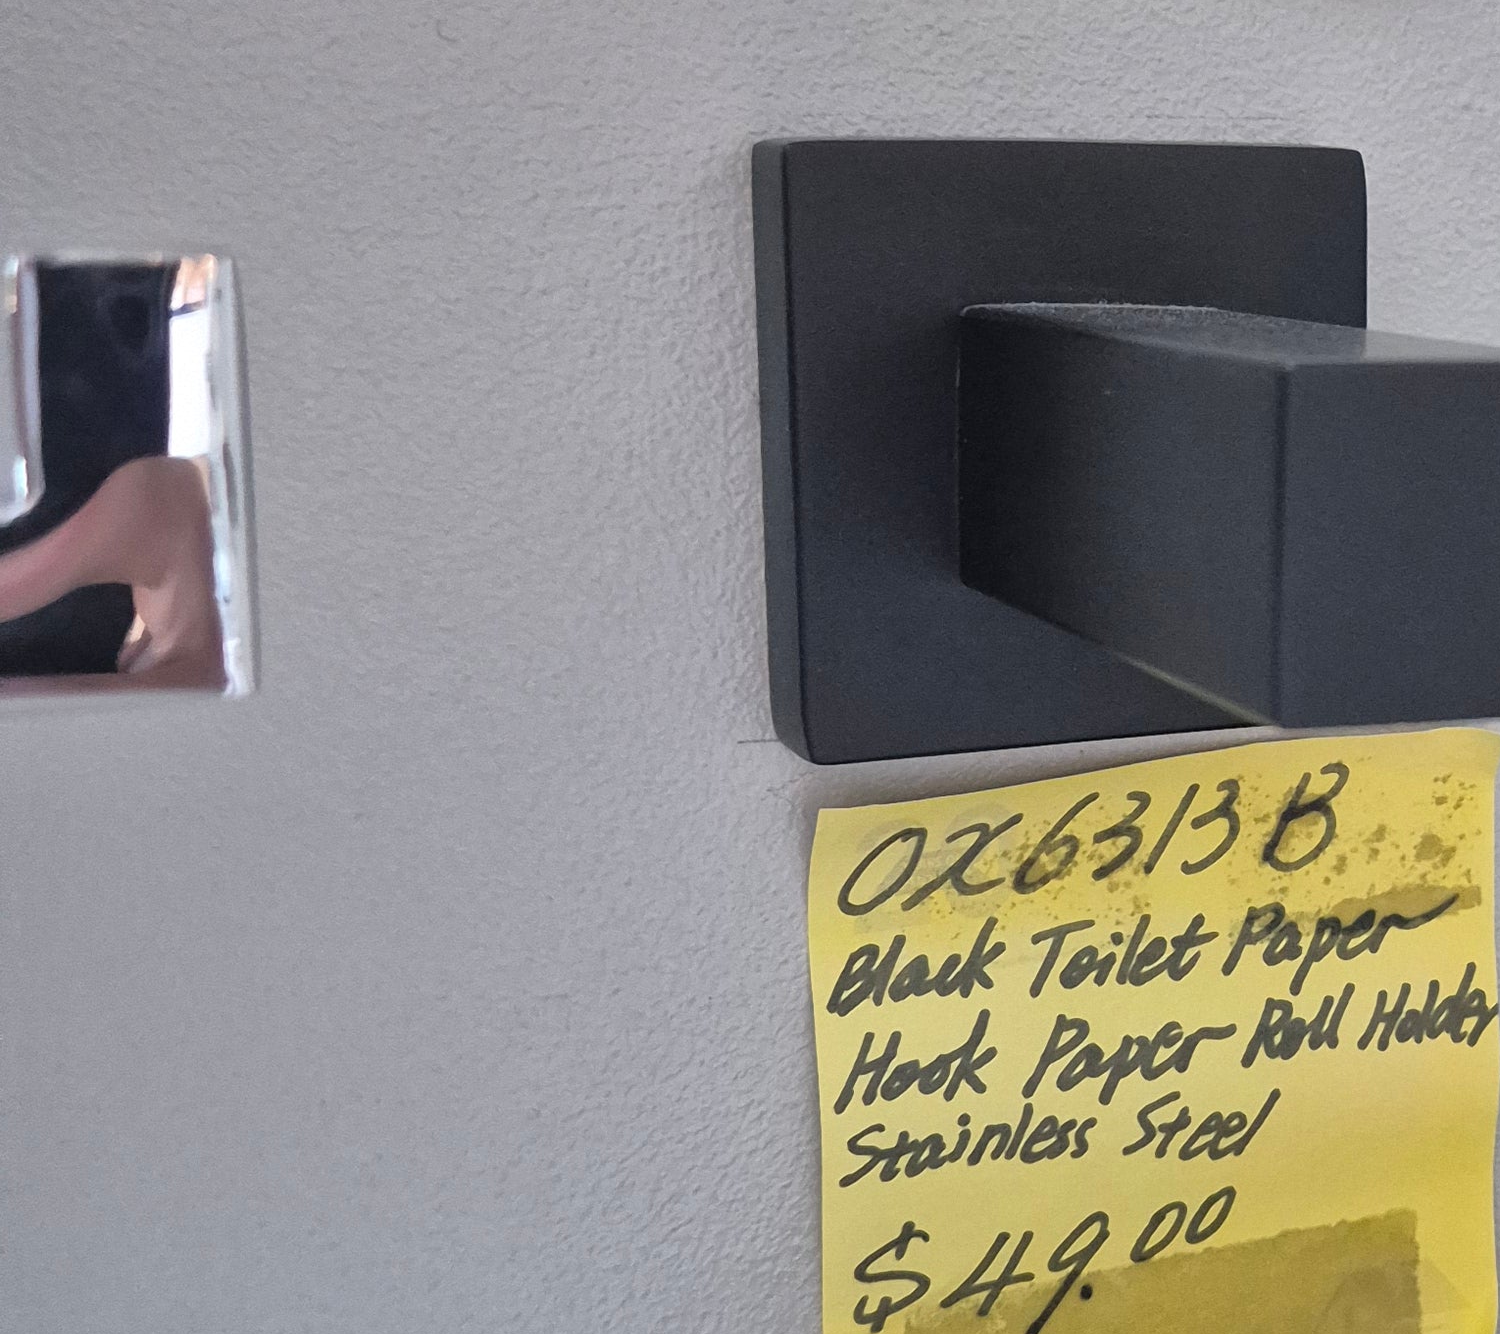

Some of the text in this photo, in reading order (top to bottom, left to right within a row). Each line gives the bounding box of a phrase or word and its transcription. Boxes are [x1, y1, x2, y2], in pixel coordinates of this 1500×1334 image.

[826, 892, 1460, 1017] Black Toilet Paper
[833, 961, 1500, 1114] Hook Paper Roll Holder
[838, 1088, 1282, 1190] Stainless Steel
